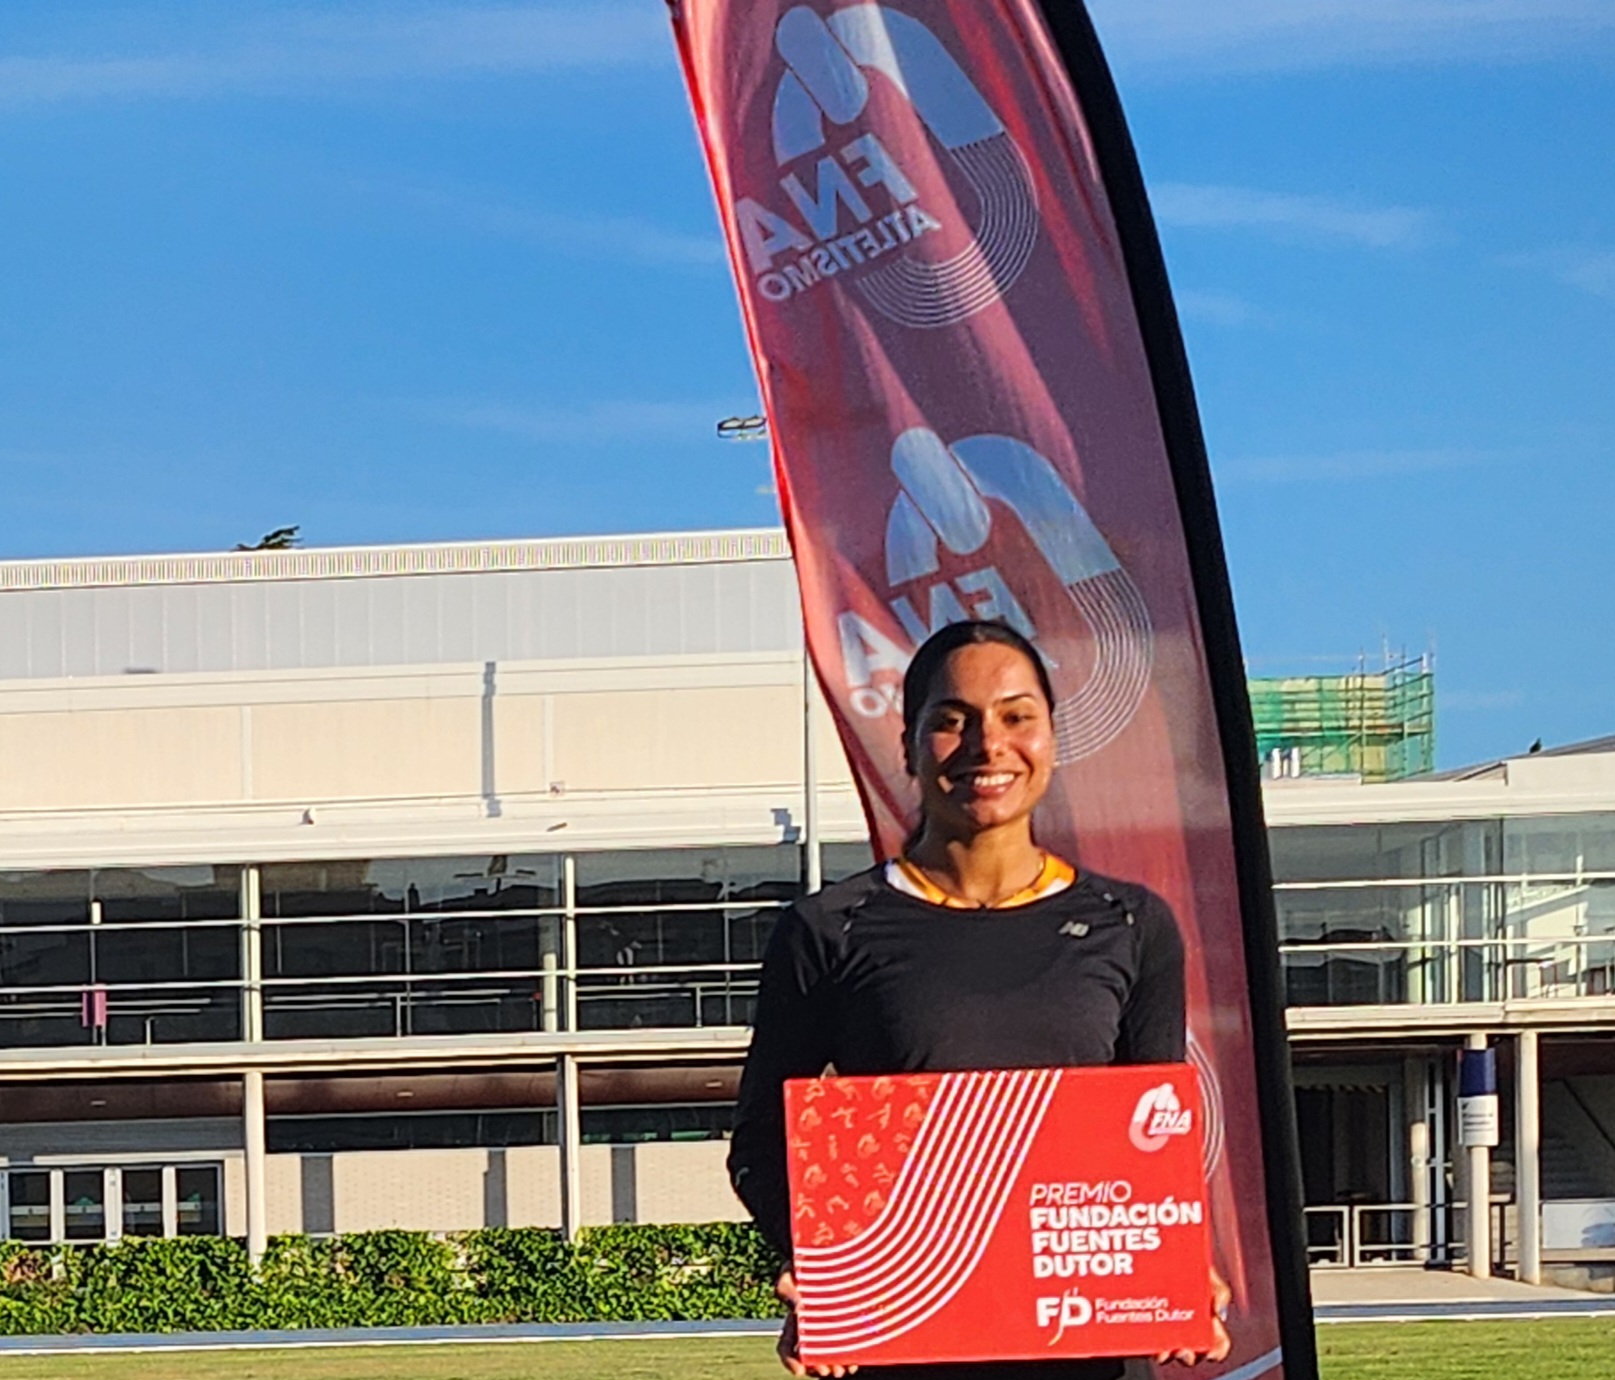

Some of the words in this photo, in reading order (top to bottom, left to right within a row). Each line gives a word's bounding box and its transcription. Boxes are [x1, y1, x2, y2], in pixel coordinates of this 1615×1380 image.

[1030, 1181, 1132, 1206] PREMIO
[1030, 1195, 1202, 1230] FUNDACIÓN
[1032, 1227, 1161, 1254] FUENTES
[1033, 1253, 1133, 1279] DUTOR
[1095, 1297, 1169, 1311] Fundación
[1095, 1311, 1153, 1324] Fuentes
[1155, 1309, 1196, 1323] Dutor
